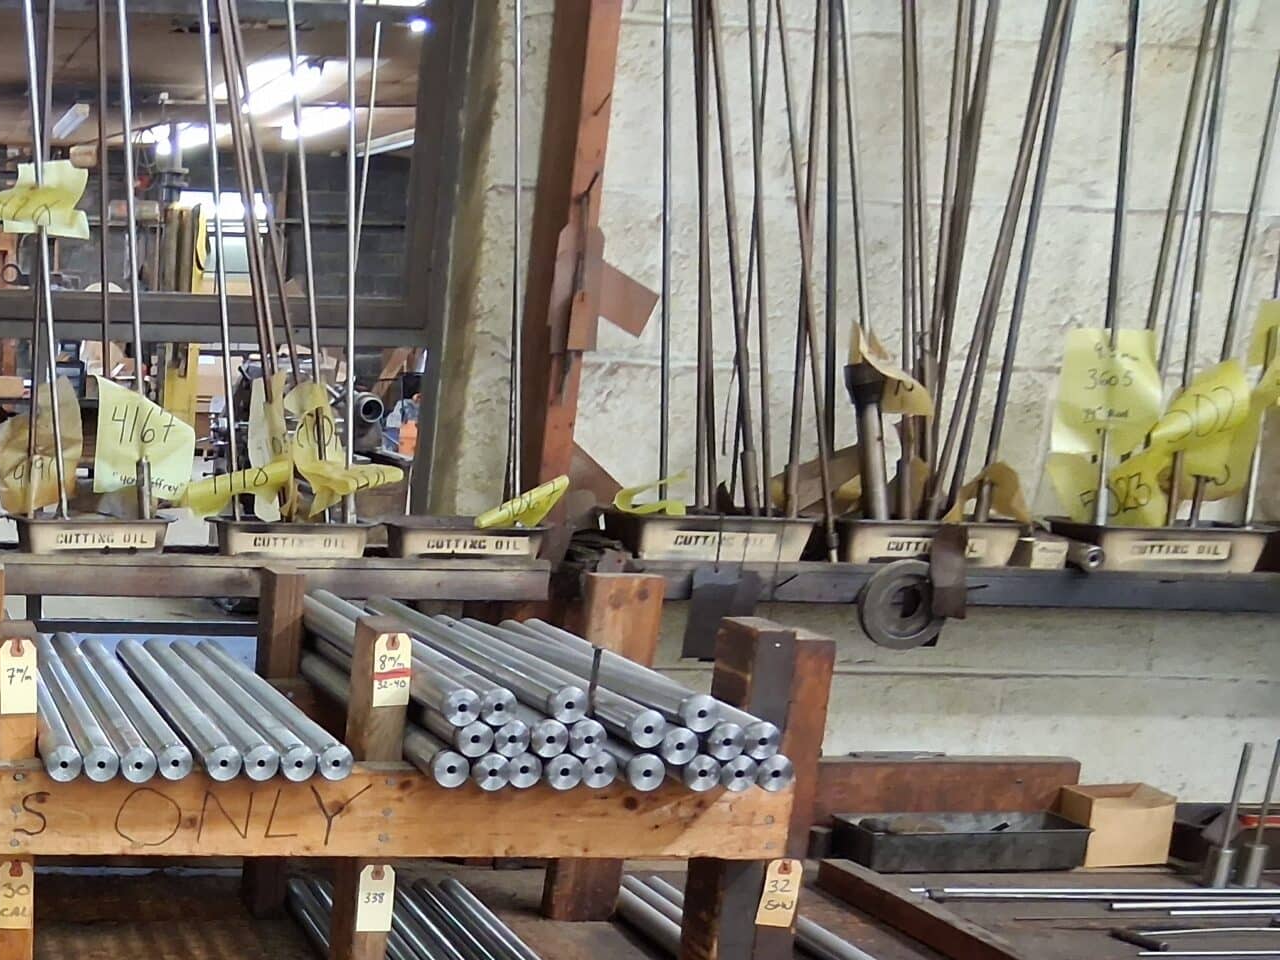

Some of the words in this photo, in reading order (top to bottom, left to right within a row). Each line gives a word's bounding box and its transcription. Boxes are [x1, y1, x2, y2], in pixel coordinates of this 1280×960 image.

[111, 404, 176, 444] 4167
[56, 532, 115, 545] CUTTING
[122, 532, 149, 545] OIL
[252, 536, 314, 549] CUTTI
[426, 538, 488, 550] CUTTING
[494, 539, 521, 551] OIL
[1197, 544, 1223, 556] OIL
[114, 783, 373, 846] ONLY
[1, 882, 31, 899] 30
[767, 879, 793, 893] 32
